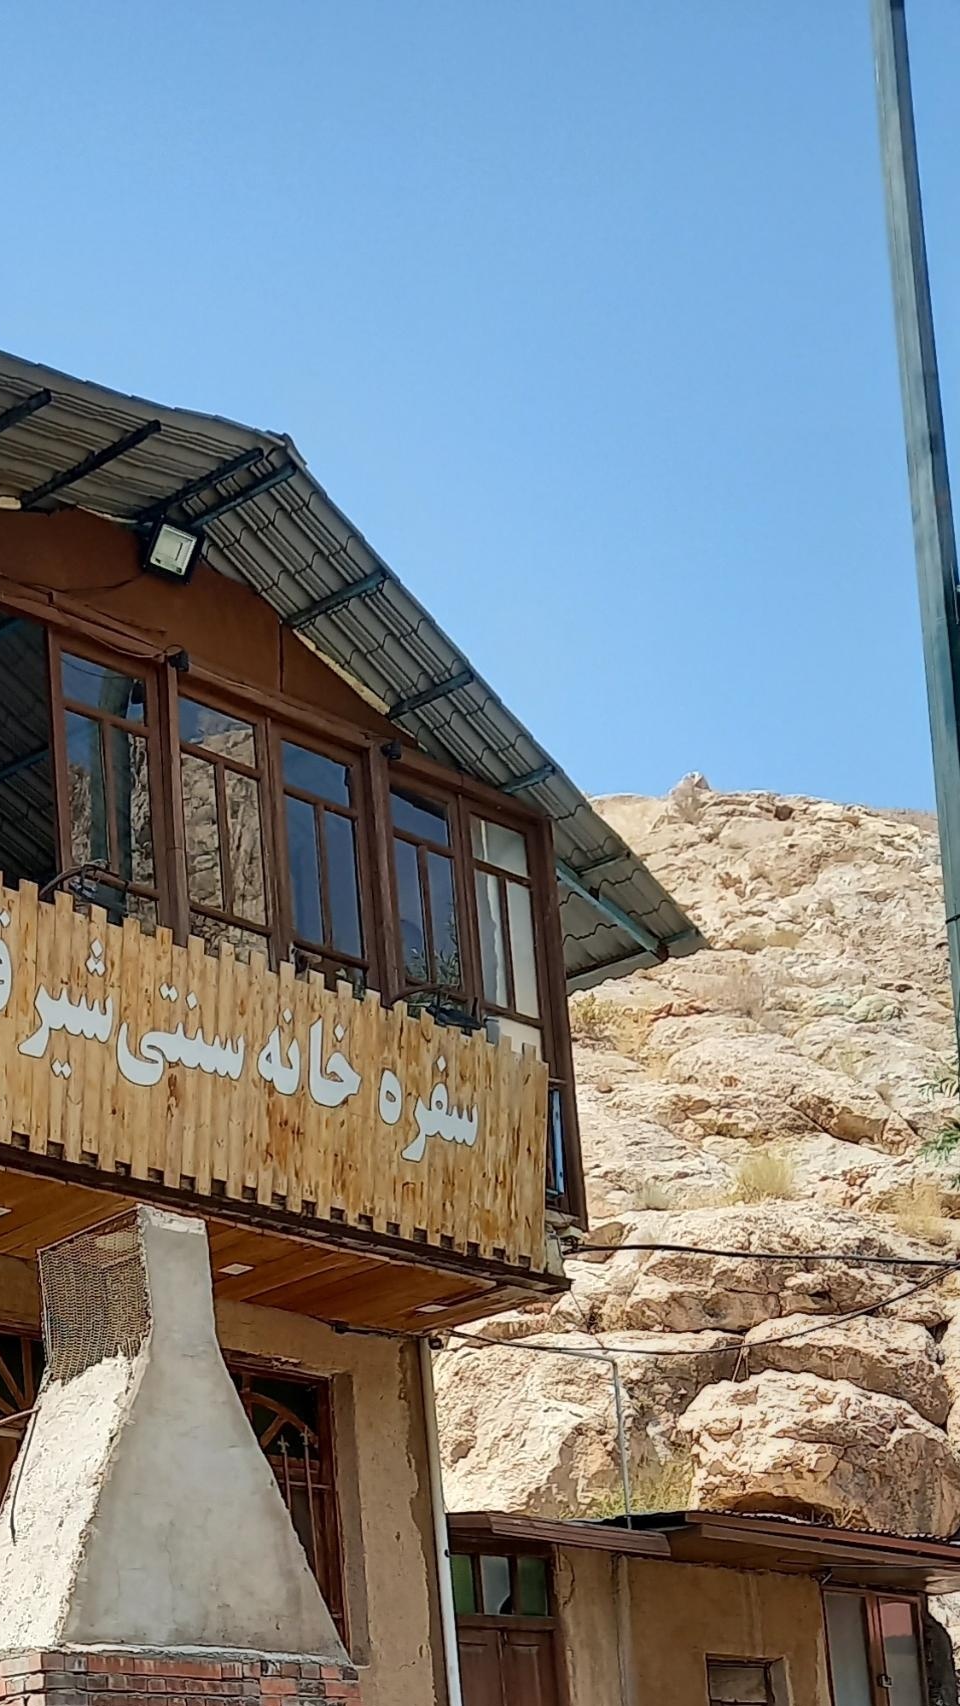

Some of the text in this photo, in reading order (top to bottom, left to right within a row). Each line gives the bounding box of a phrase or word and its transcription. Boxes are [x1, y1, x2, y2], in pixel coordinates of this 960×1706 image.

[18, 939, 114, 1078] شیر
[116, 985, 246, 1087] سنتی
[256, 1008, 362, 1108] خانه
[378, 1055, 479, 1162] سفره
